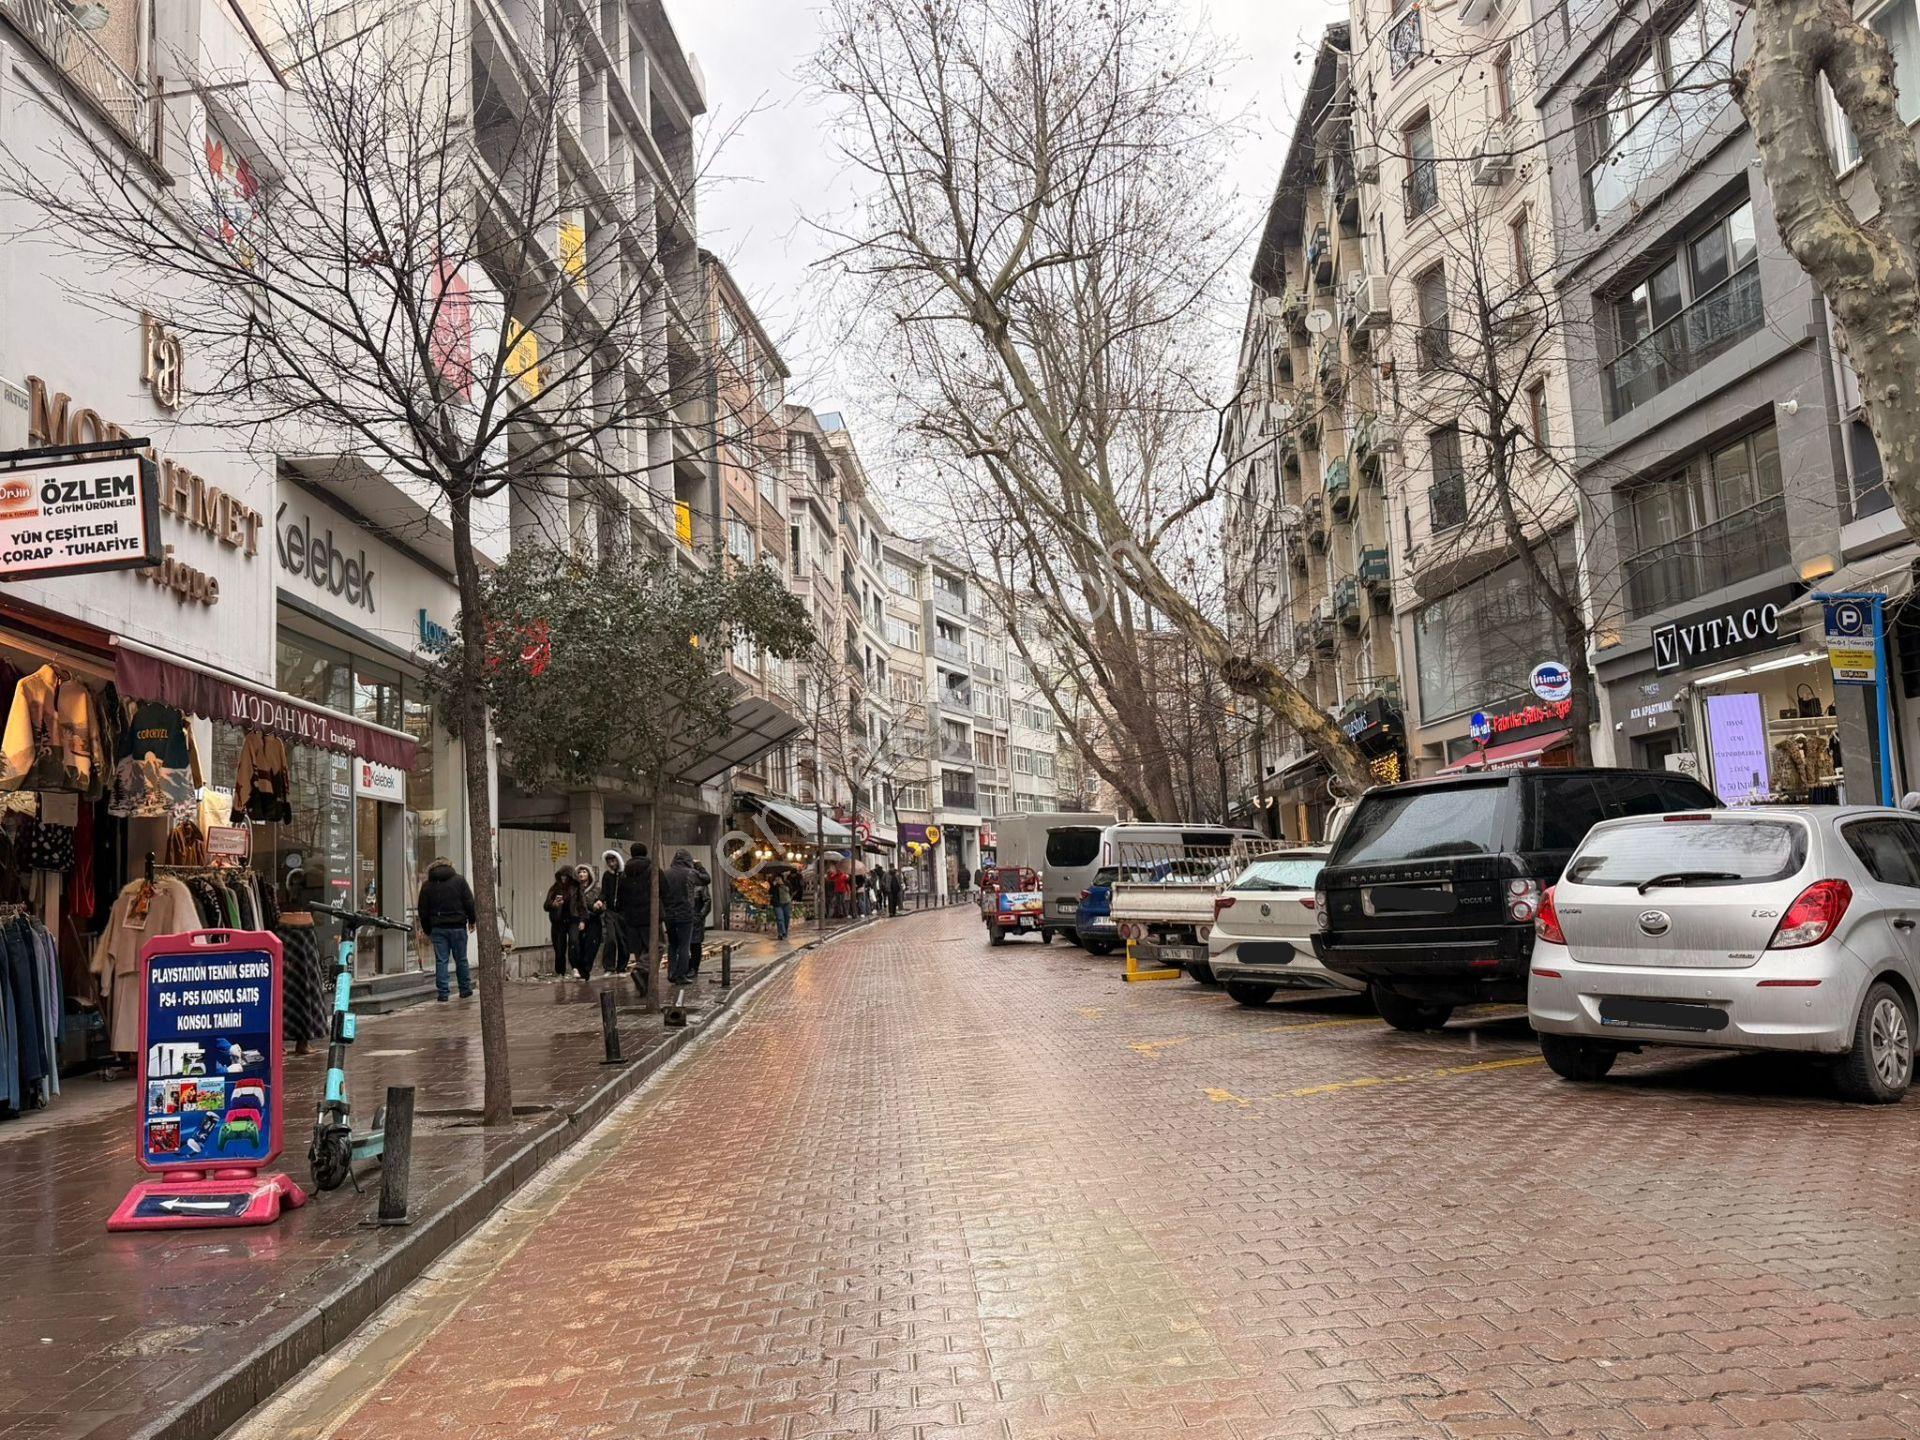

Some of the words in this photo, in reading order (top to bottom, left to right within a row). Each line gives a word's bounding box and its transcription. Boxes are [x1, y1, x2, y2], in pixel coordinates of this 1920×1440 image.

[4, 388, 29, 410] ALTUS
[41, 474, 135, 505] ÖZLEM
[43, 506, 53, 517] İÇ
[55, 502, 84, 516] GİYİM
[86, 496, 136, 511] ÜRÜNLERİ
[11, 530, 42, 546] YÜN
[45, 520, 119, 542] ÇEŞİTLERİ
[3, 547, 53, 565] ÇORAP
[65, 537, 139, 556] TUHAFİYE
[276, 502, 375, 614] Kelebek
[1680, 603, 1779, 656] VITACO
[1658, 633, 1673, 662] V
[231, 690, 327, 742] MODAHMET
[1493, 709, 1523, 733] Fabrika
[371, 770, 395, 790] Kelebek
[1350, 873, 1396, 883] RANGE
[1404, 869, 1454, 879] ROVER
[152, 967, 206, 984] PLAYSTATION
[208, 961, 238, 981] TEKNİK
[239, 959, 269, 979] SERVİS
[160, 992, 176, 1007] PS4
[183, 990, 200, 1006] PS5
[201, 989, 235, 1005] KONSOL
[236, 987, 259, 1006] SATIŞ
[177, 1014, 212, 1031] KONSOL
[213, 1008, 242, 1029] TAMİRİ
